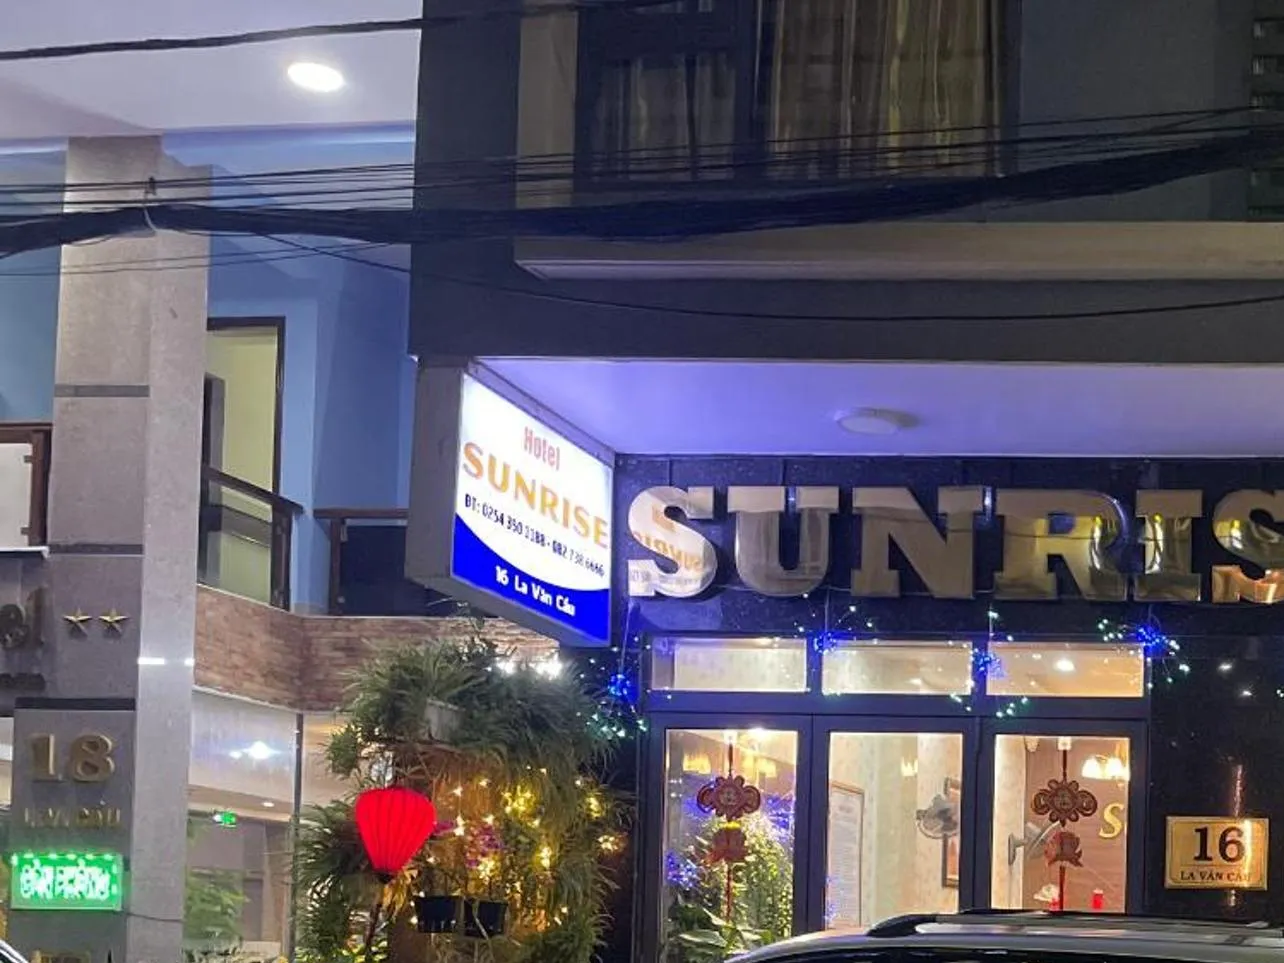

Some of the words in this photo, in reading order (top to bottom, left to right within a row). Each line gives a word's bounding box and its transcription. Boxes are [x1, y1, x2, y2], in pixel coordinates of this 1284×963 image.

[523, 426, 561, 471] Hotel
[462, 441, 609, 550] SUNRISE
[495, 565, 510, 586] 16
[514, 574, 529, 595] La
[27, 734, 116, 783] 18
[1193, 826, 1245, 863] 16
[1180, 870, 1196, 881] LA
